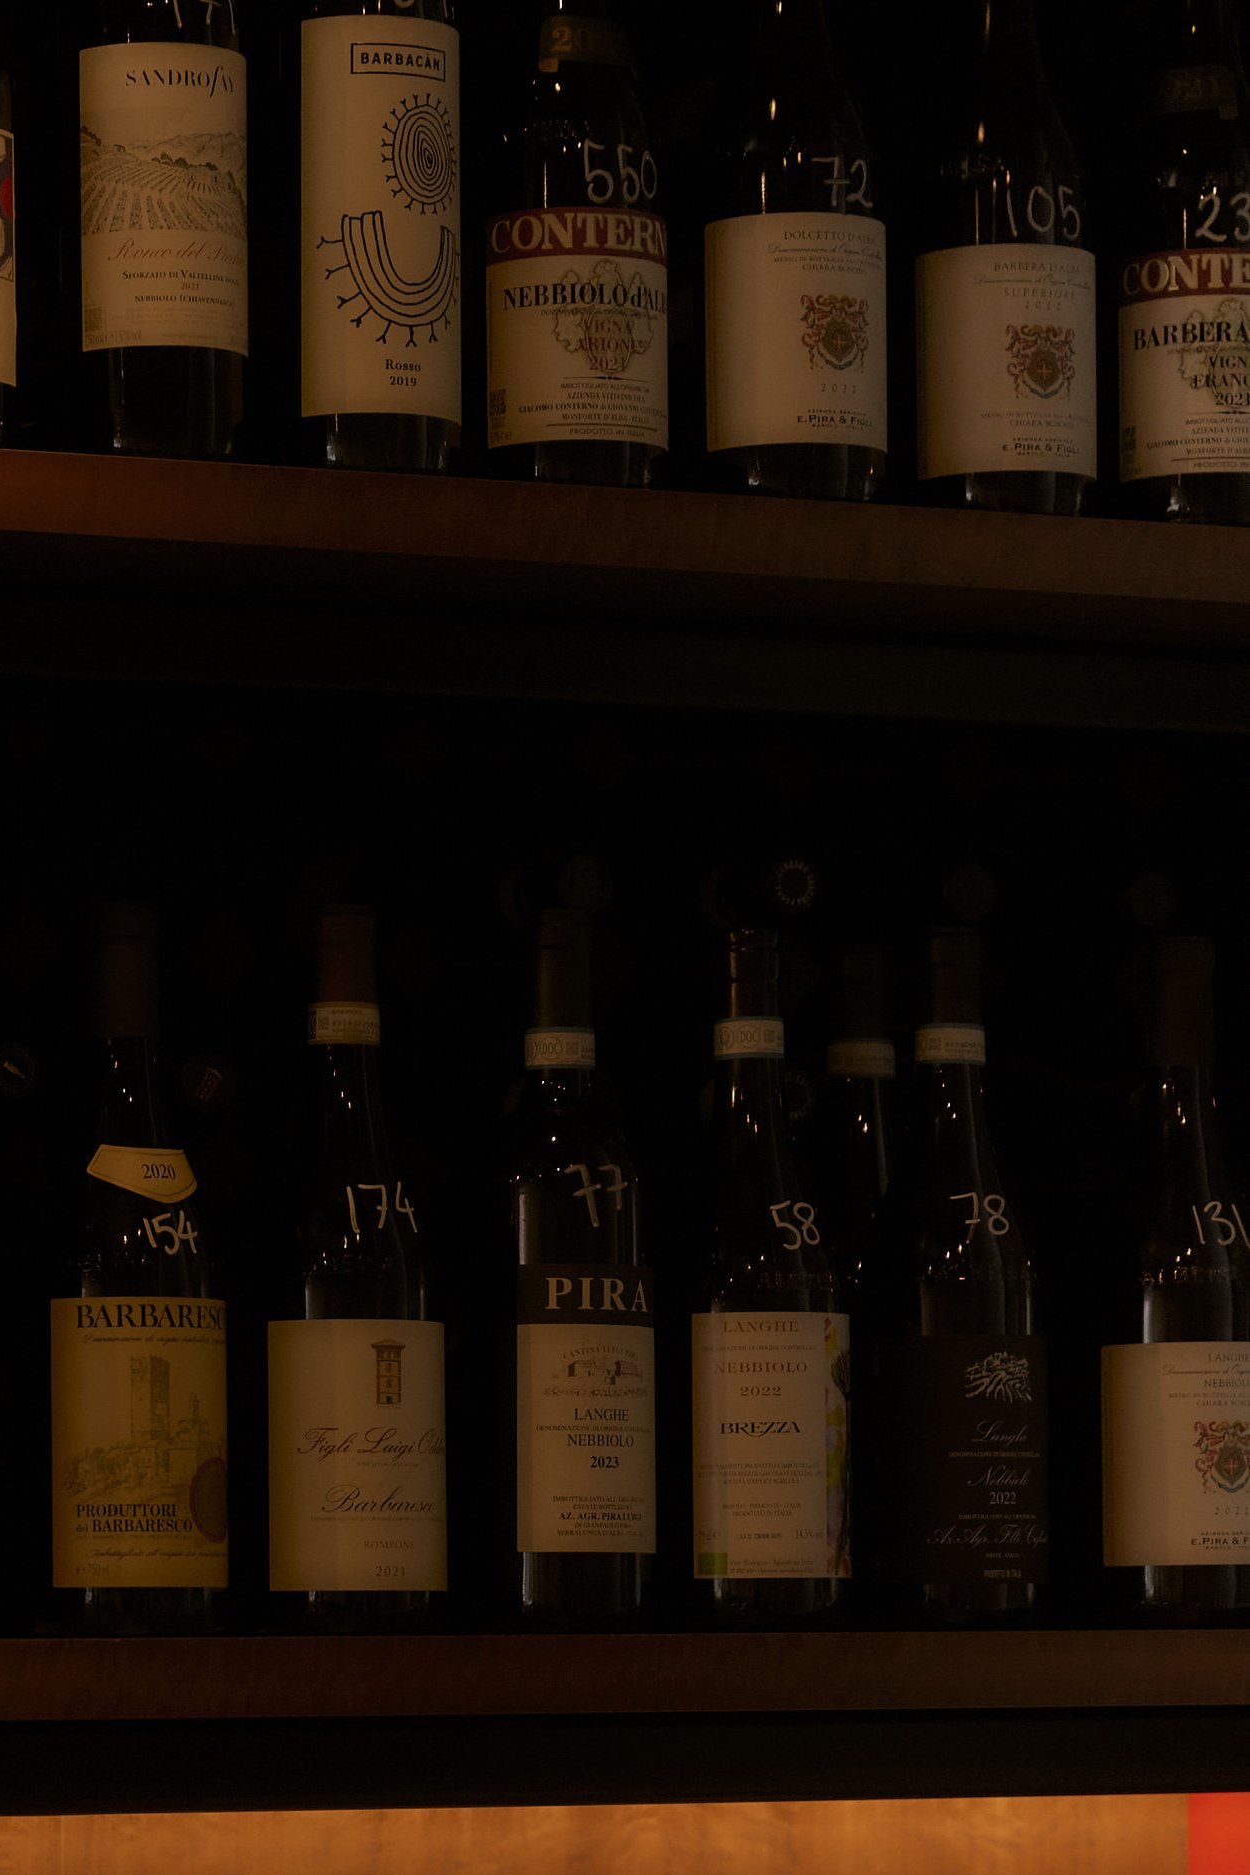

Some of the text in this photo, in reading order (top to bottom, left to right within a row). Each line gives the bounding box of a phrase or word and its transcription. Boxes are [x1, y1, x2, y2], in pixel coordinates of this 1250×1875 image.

[583, 139, 658, 204] 550
[811, 155, 874, 209] 72
[1006, 185, 1081, 240] 105
[503, 282, 628, 310] NEBBIOLO
[385, 359, 421, 373] Rosso
[389, 375, 417, 387] 2019
[141, 1163, 176, 1180] 2020
[564, 1164, 628, 1227] 77
[346, 1181, 419, 1233] 174
[770, 1199, 820, 1250] 58
[950, 1192, 1010, 1245] 78
[143, 1210, 198, 1256] 154
[545, 1277, 648, 1313] PIRA
[724, 1321, 799, 1333] LANGHE
[715, 1362, 807, 1374] NEBBIOLO
[740, 1386, 782, 1397] 2022
[574, 1408, 629, 1421] LANGHE
[720, 1421, 801, 1437] BREZZA
[567, 1434, 634, 1447] NEBBIOLO
[589, 1456, 619, 1469] 2023
[989, 1491, 1017, 1504] 2022
[76, 1503, 177, 1517] PRODUTTORI
[92, 1519, 193, 1533] BARBARESCO
[376, 1566, 405, 1577] 2021
